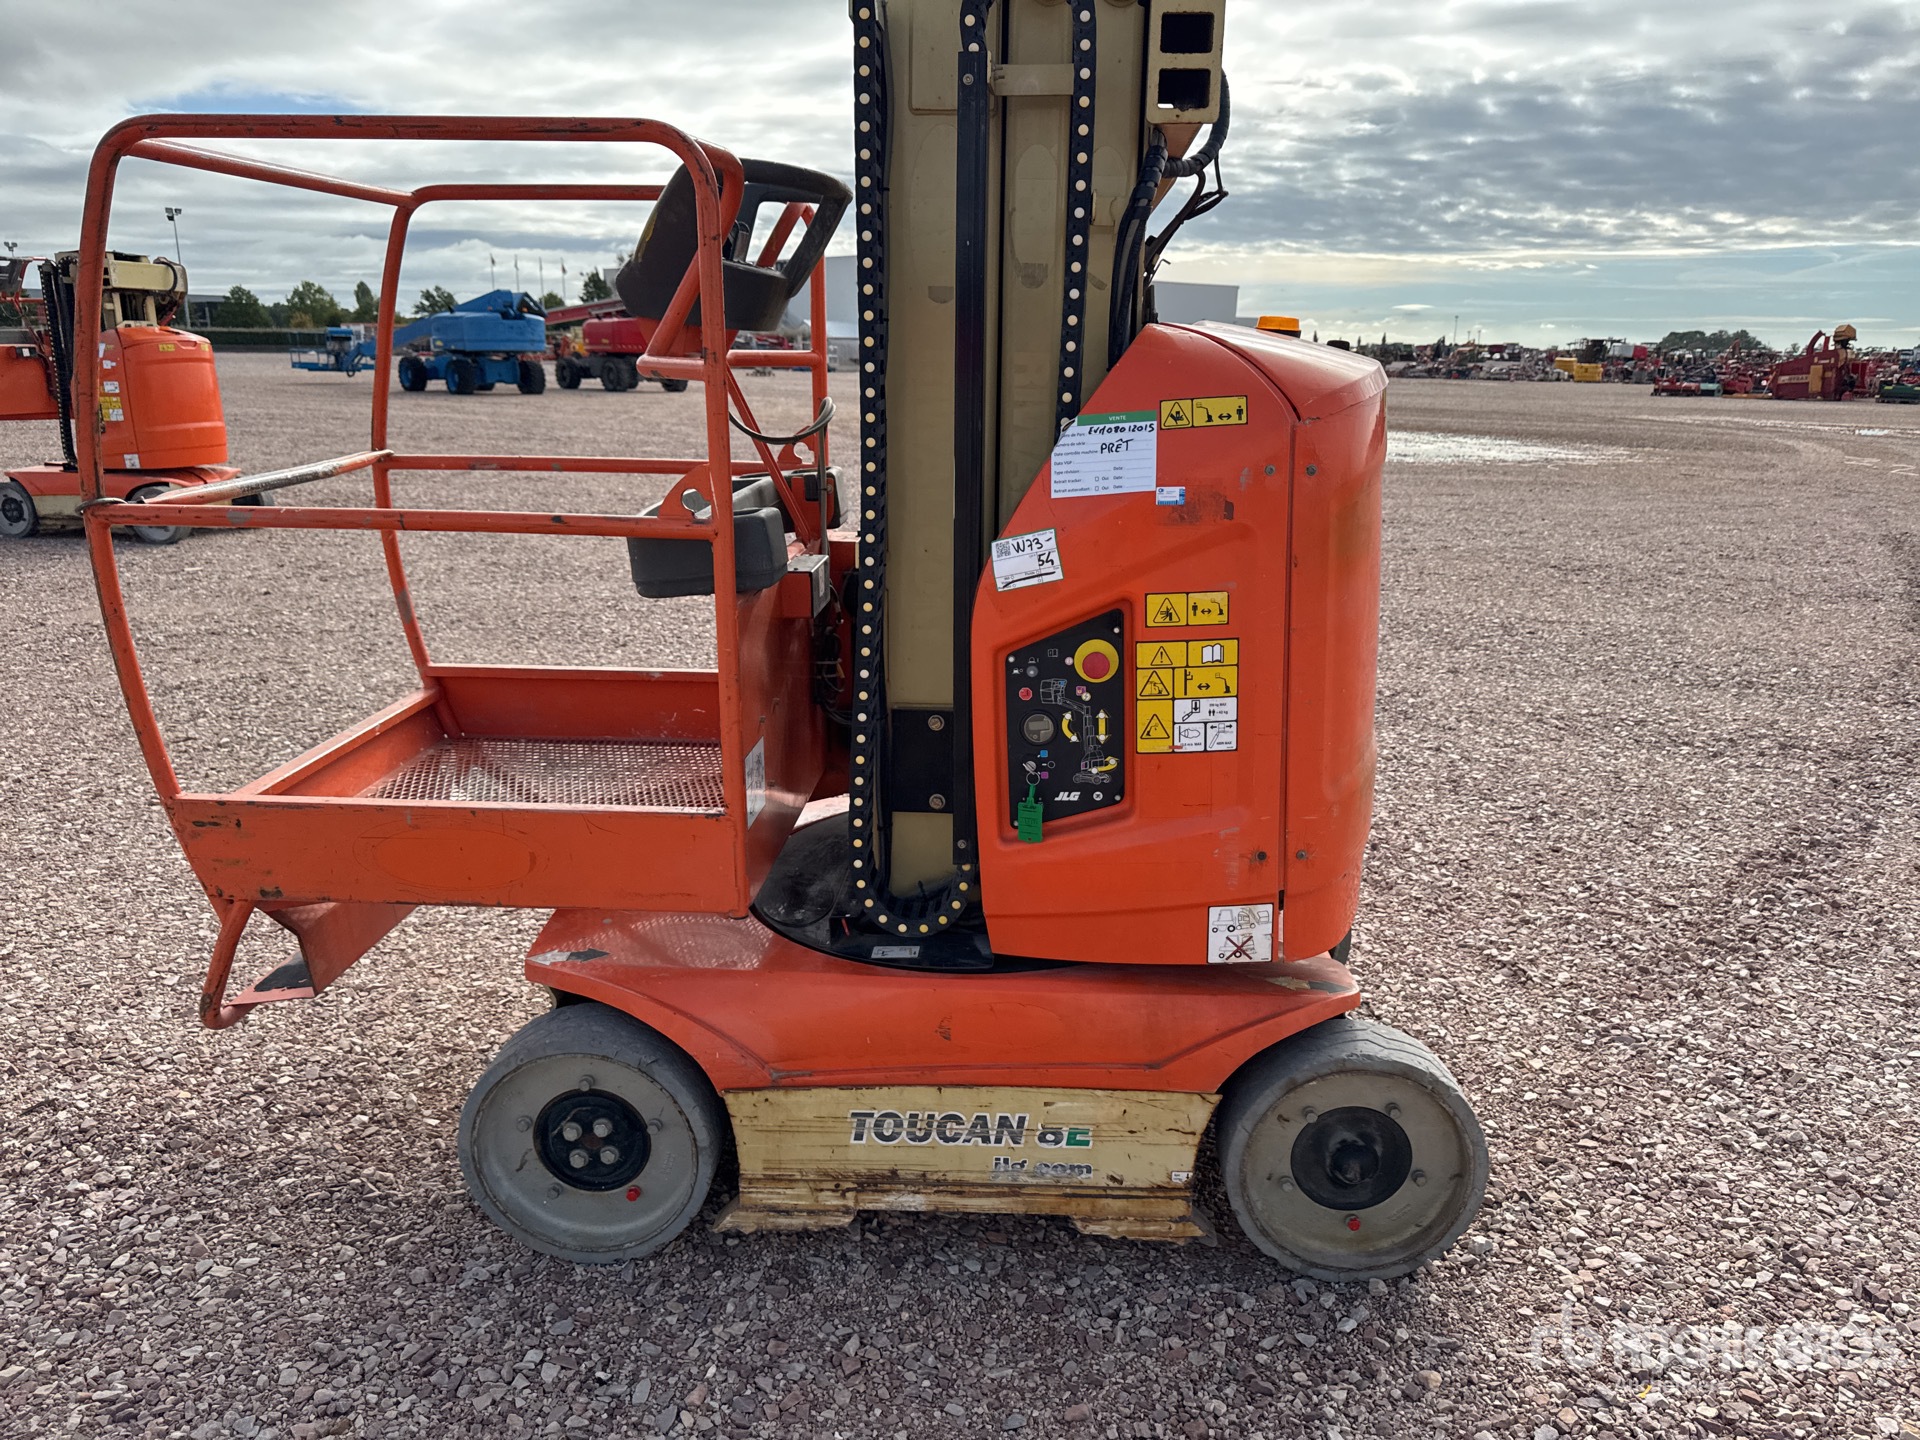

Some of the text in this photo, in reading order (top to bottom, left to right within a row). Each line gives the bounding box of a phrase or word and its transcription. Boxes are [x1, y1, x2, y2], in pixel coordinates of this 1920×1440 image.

[1100, 438, 1134, 454] PRÊT
[1038, 551, 1054, 566] 54
[1054, 791, 1081, 801] JLG
[849, 1111, 1028, 1146] TOUCAN
